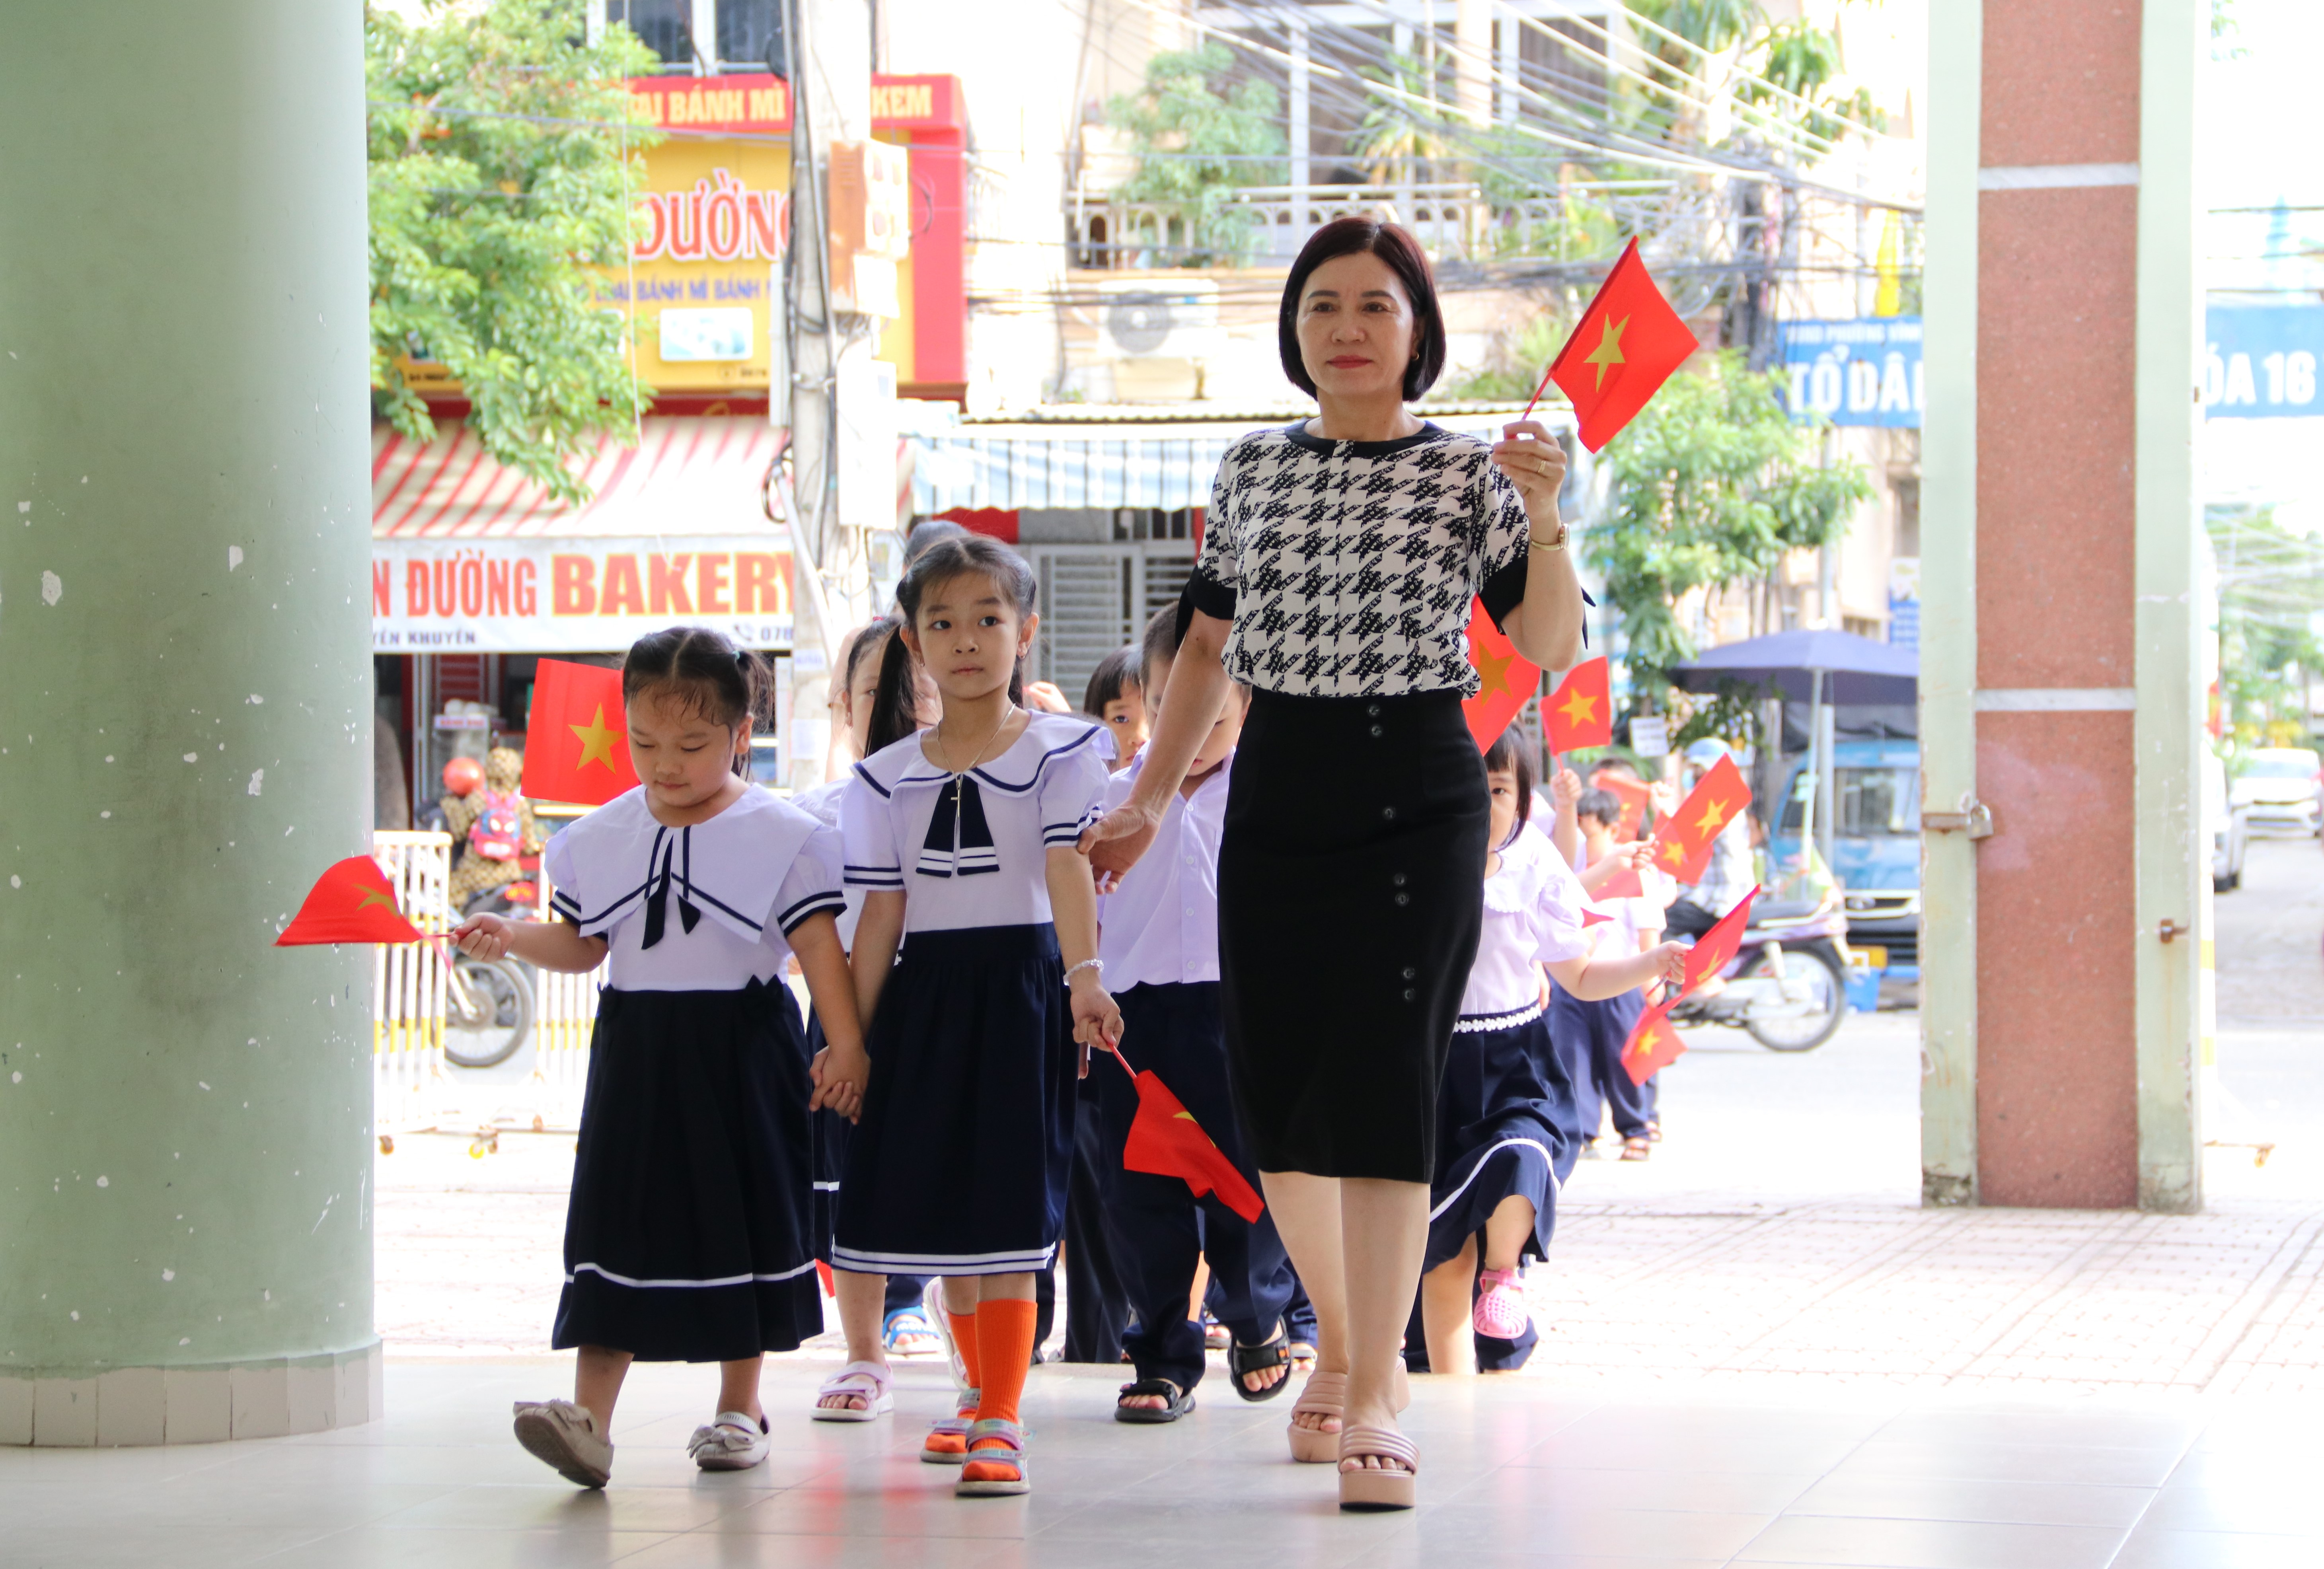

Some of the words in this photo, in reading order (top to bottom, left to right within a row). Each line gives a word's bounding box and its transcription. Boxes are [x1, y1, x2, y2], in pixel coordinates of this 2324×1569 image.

[668, 84, 744, 123] BÁNH
[749, 81, 785, 121] MÌ
[870, 84, 933, 118] KEM
[637, 274, 684, 301] BÁNH
[2206, 341, 2257, 406] ÓA
[405, 547, 537, 618] ĐƯỜNG
